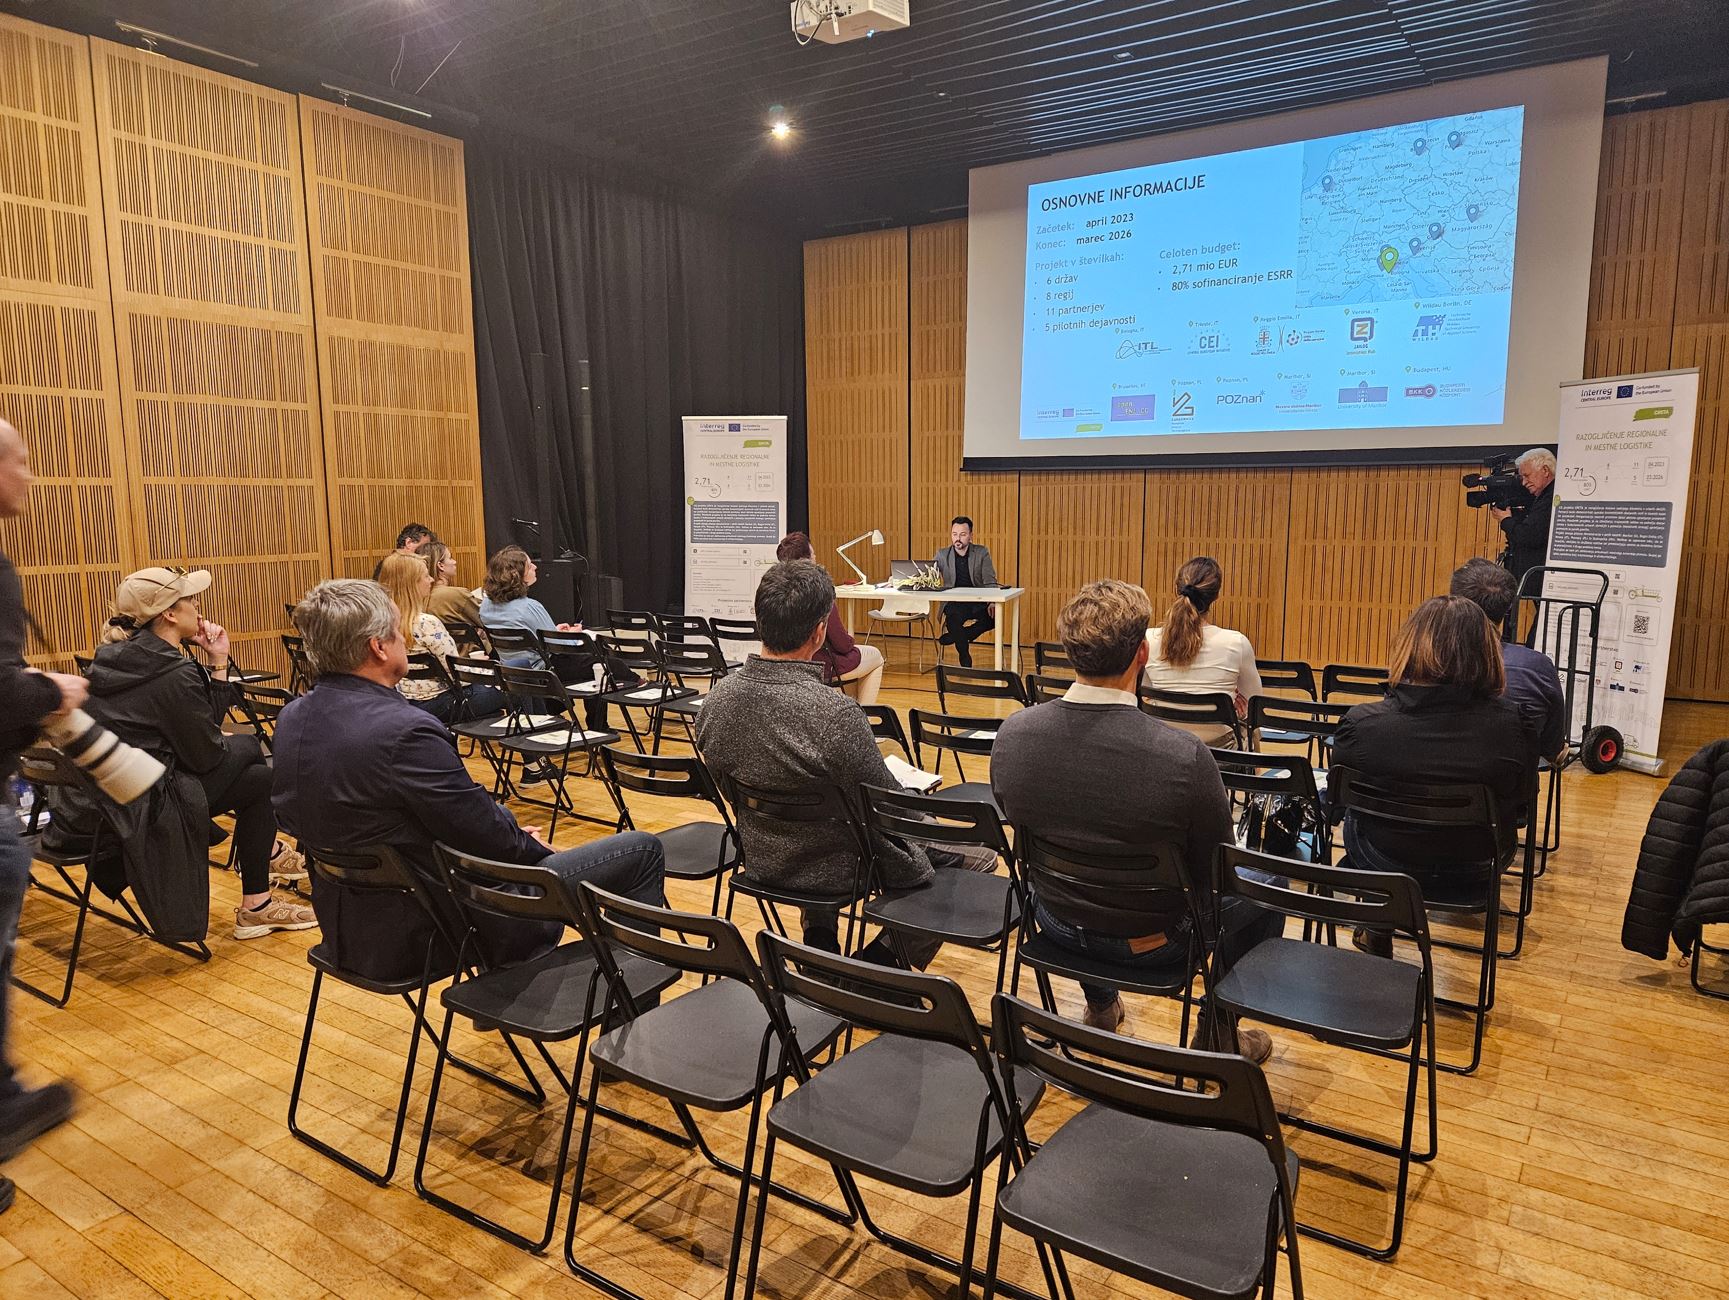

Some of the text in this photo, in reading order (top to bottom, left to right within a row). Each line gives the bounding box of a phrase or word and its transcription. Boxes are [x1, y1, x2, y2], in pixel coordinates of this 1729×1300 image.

[1042, 174, 1206, 211] OSNOVNE INFORMACIJE
[1036, 213, 1134, 235] Začetek: april 2023
[1036, 229, 1132, 251] Konec: marec 2026
[1160, 242, 1240, 259] Celoten budget:
[1035, 259, 1068, 272] Projekt
[1079, 253, 1124, 266] številkah:
[1172, 258, 1238, 275] 2,71 mio EUR
[1047, 274, 1078, 285] 6 držav
[1171, 270, 1293, 291] 80% sofinanciranje ESRR
[1054, 289, 1074, 301] regij
[1046, 303, 1105, 317] 11 partnerjev
[1052, 320, 1086, 333] pilotnih
[1089, 315, 1136, 328] dejavnosti
[1138, 342, 1158, 350] ITL
[1200, 335, 1219, 349] CEI
[1217, 394, 1262, 404] POZnan
[1580, 388, 1612, 397] Interreg
[1564, 467, 1584, 479] 2,71
